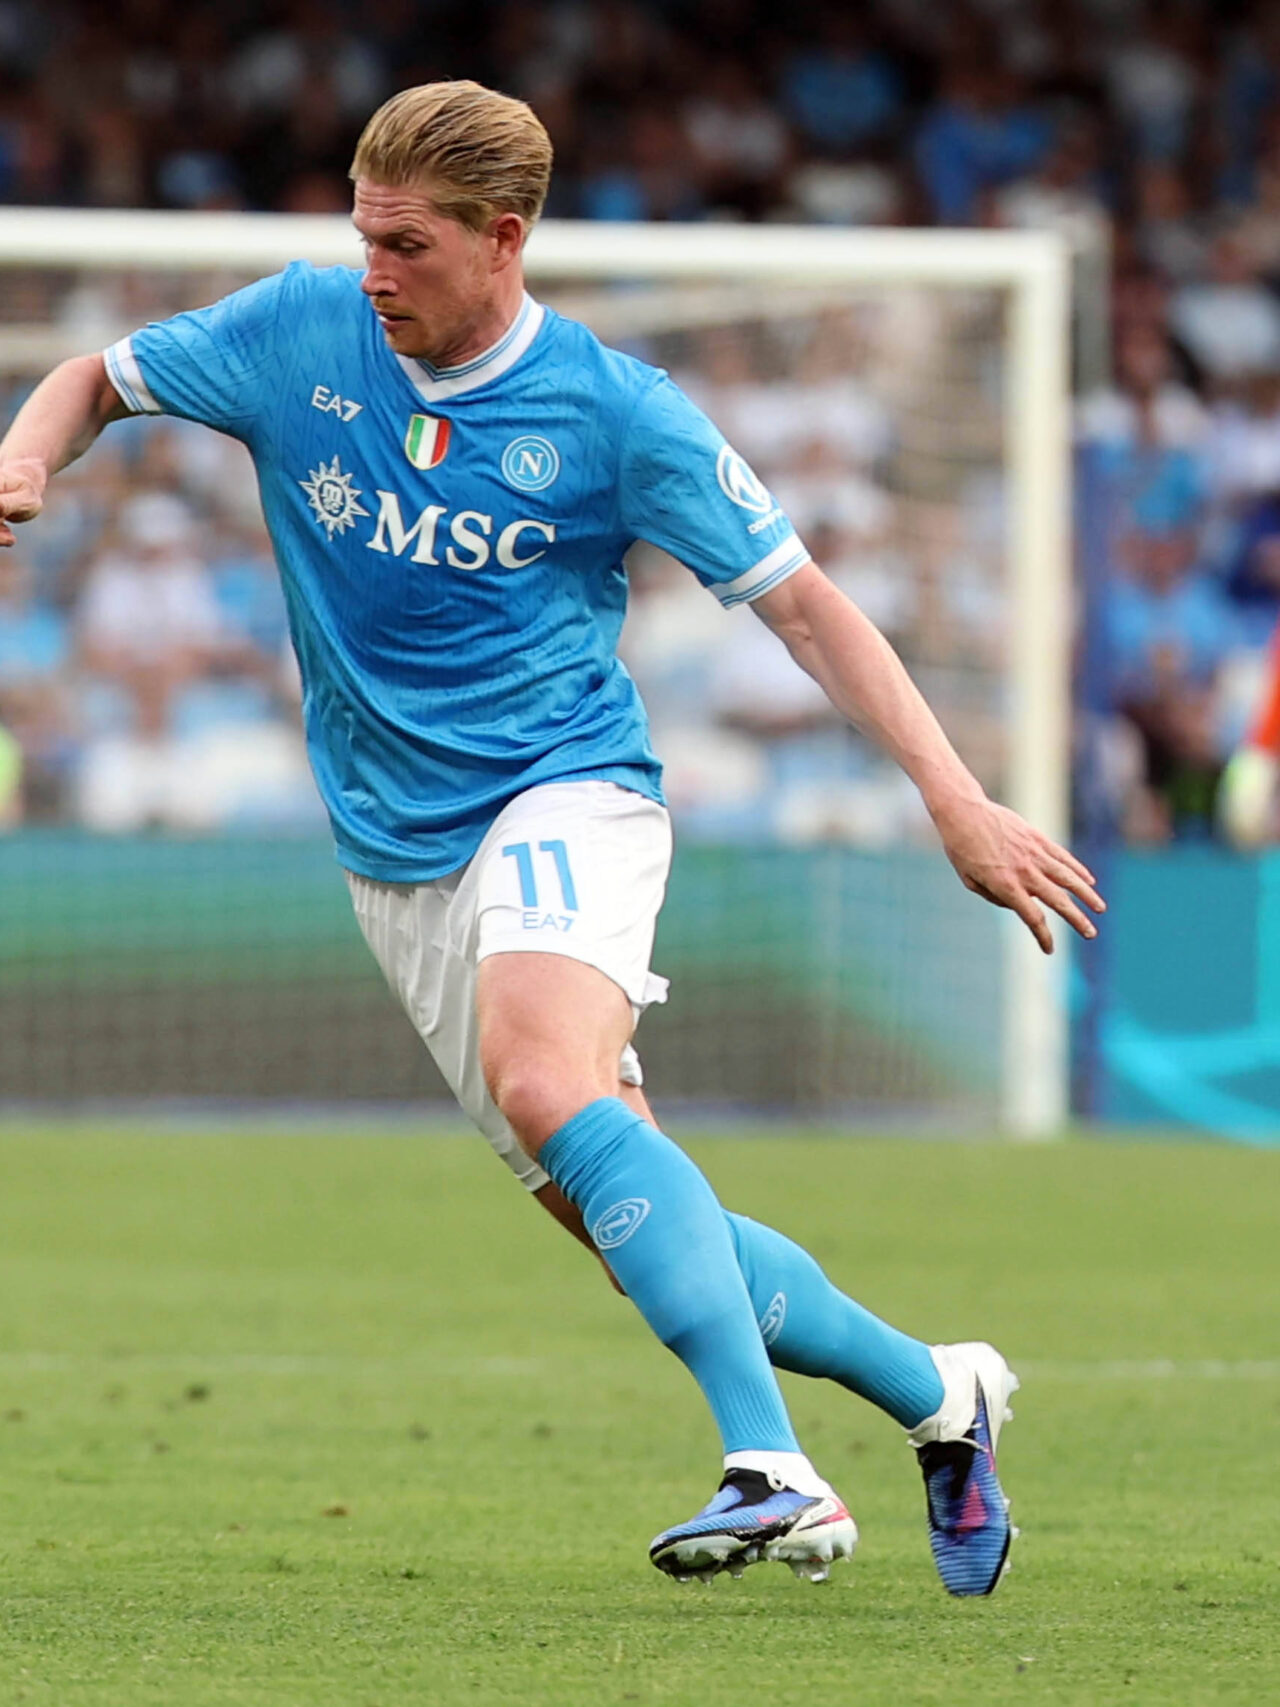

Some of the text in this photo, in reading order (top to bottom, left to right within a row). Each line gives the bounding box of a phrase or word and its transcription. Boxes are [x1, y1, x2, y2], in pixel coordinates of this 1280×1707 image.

[311, 385, 363, 422] EA7
[516, 451, 545, 477] N
[366, 489, 556, 571] MSC
[502, 839, 579, 912] 11
[522, 911, 575, 932] EA7
